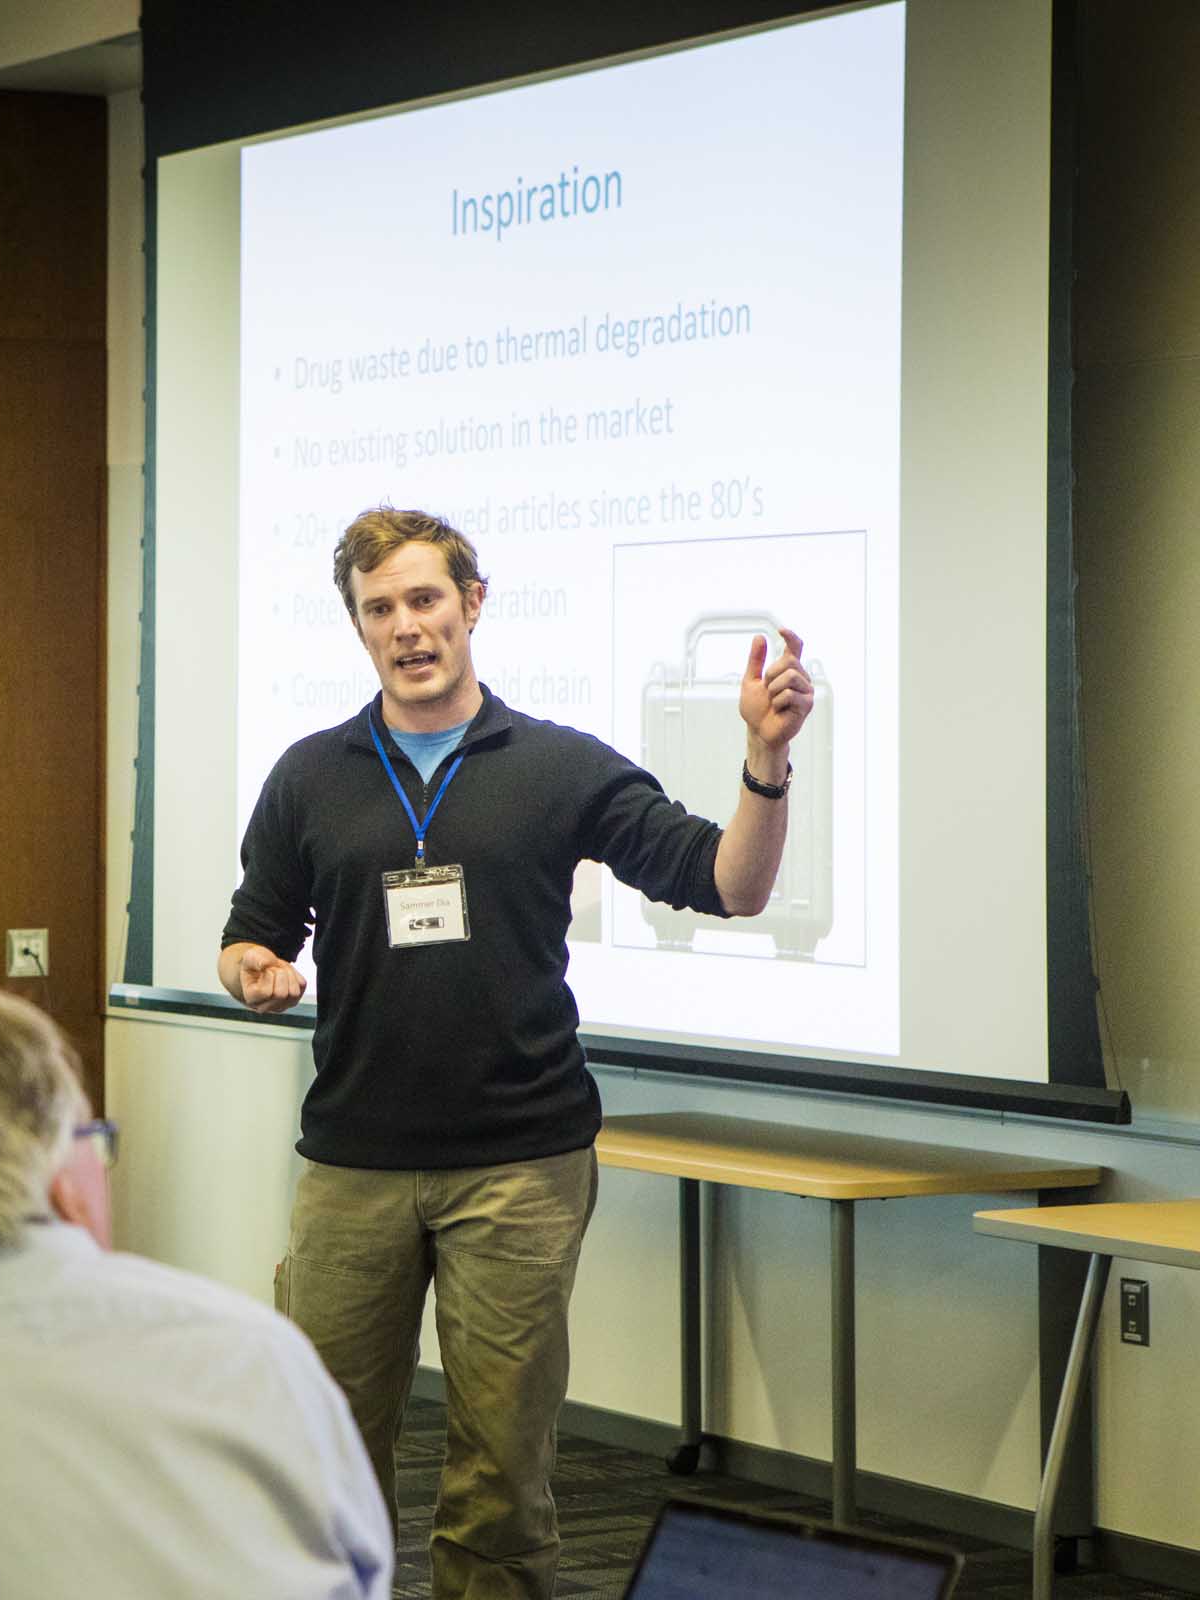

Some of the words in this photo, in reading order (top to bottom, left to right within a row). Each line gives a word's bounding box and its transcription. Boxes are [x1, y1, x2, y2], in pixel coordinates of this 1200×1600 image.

[452, 165, 623, 241] Inspiration
[294, 355, 344, 395] Drug
[350, 345, 411, 385] waste
[416, 336, 459, 375] due
[464, 334, 489, 369] to
[495, 314, 588, 365] thermal
[595, 298, 752, 359] degradation
[294, 433, 323, 469] No
[327, 423, 409, 469] existing
[415, 414, 503, 457] solution
[511, 409, 535, 448] in
[539, 404, 577, 446] the
[585, 396, 675, 440] market
[292, 510, 330, 548] 20+
[497, 490, 582, 534] articles
[588, 489, 650, 528] since
[659, 479, 703, 523] the
[290, 671, 380, 708] Complia
[528, 664, 593, 705] chain
